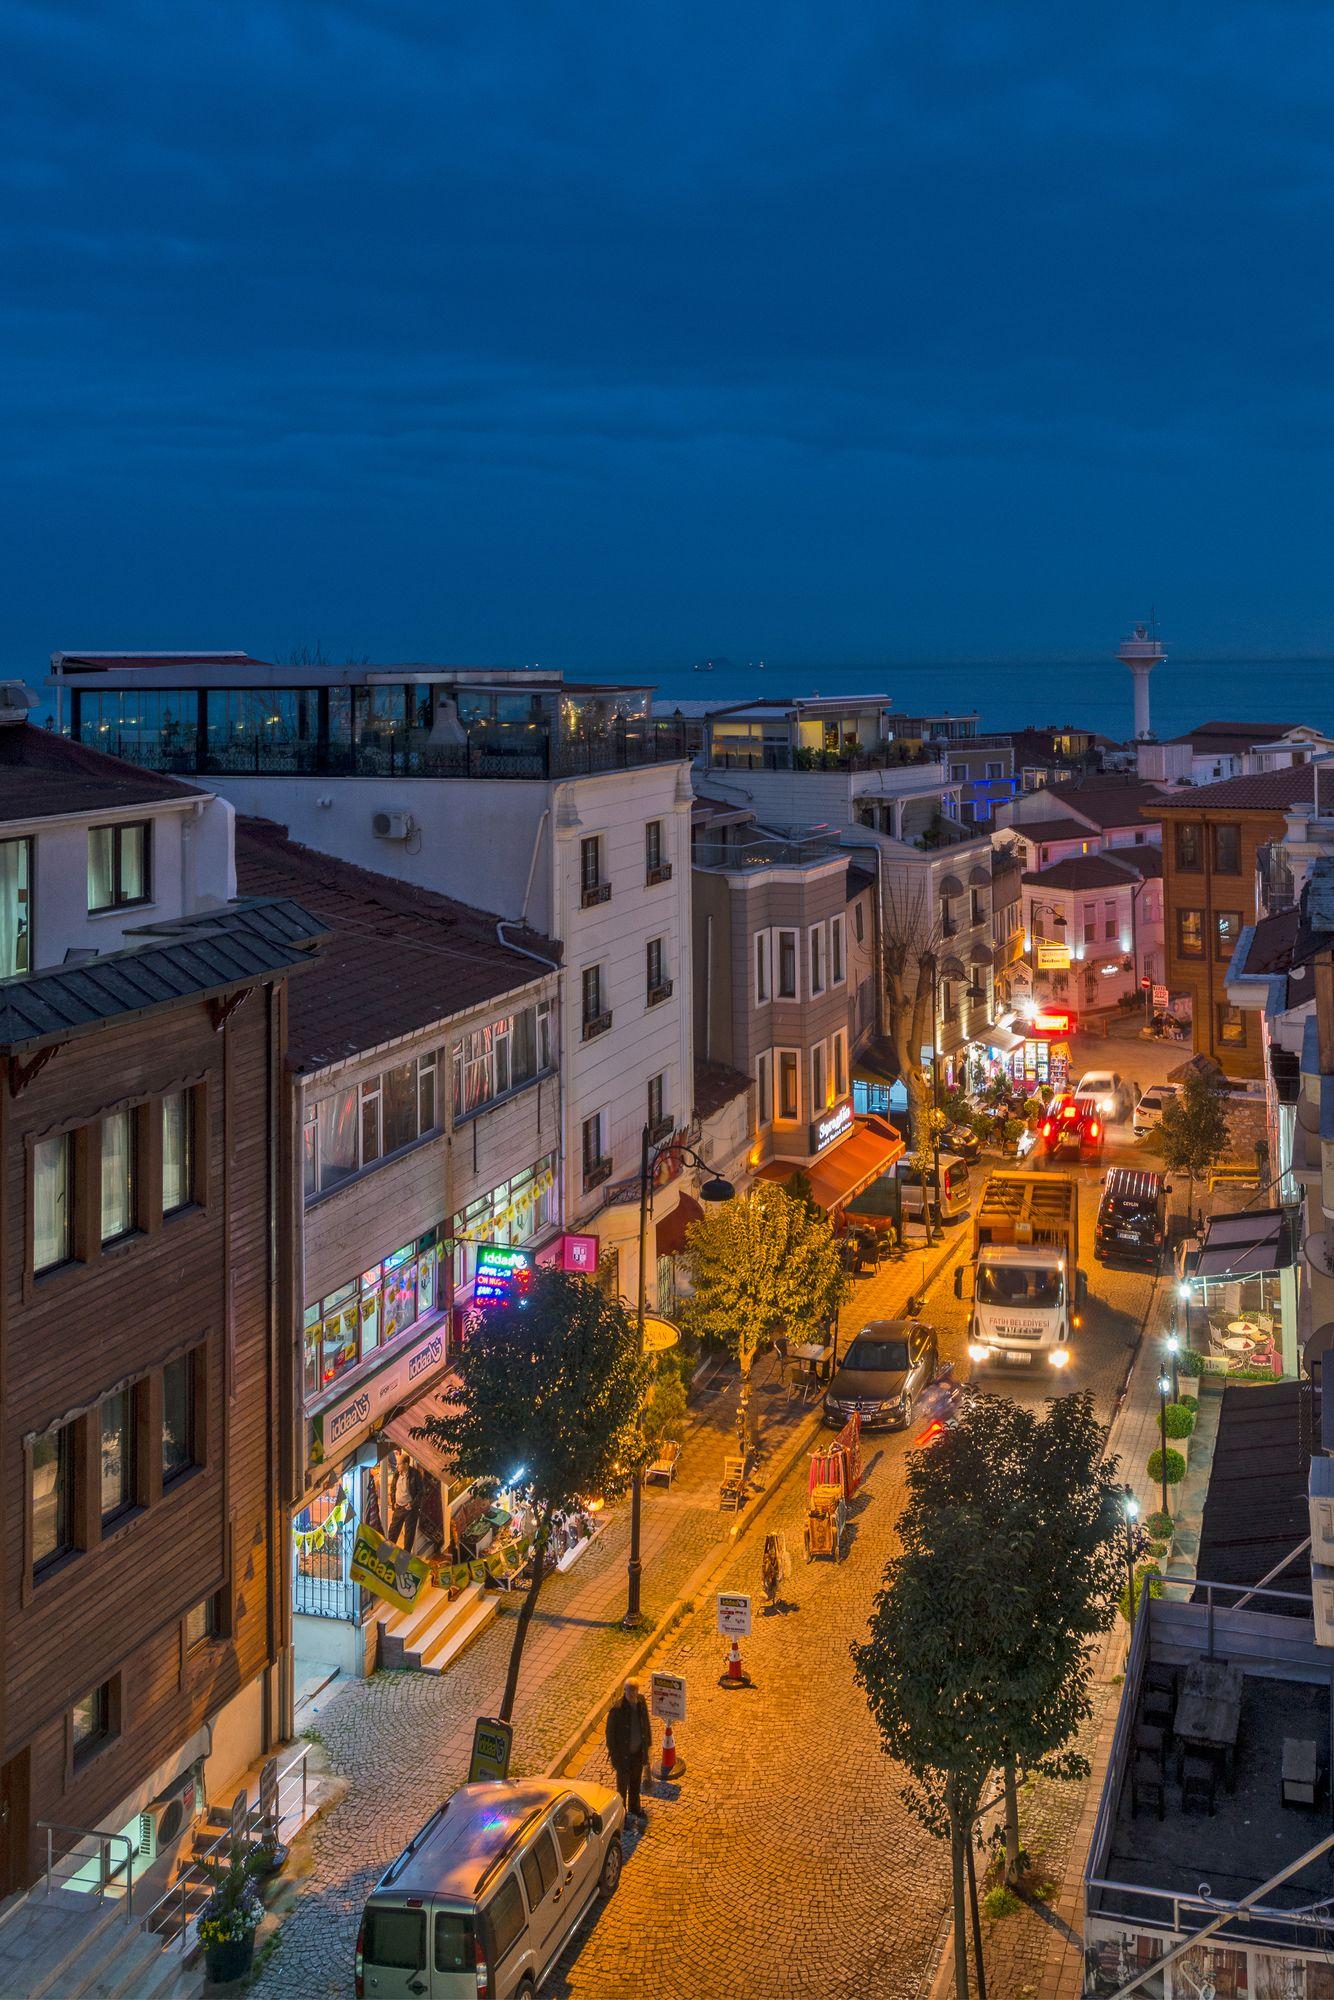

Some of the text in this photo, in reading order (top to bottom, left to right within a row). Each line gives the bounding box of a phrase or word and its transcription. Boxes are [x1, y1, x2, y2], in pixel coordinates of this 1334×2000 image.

[409, 1350, 433, 1380] iddaa
[331, 1409, 358, 1441] iddaa
[353, 1541, 397, 1585] iddaa
